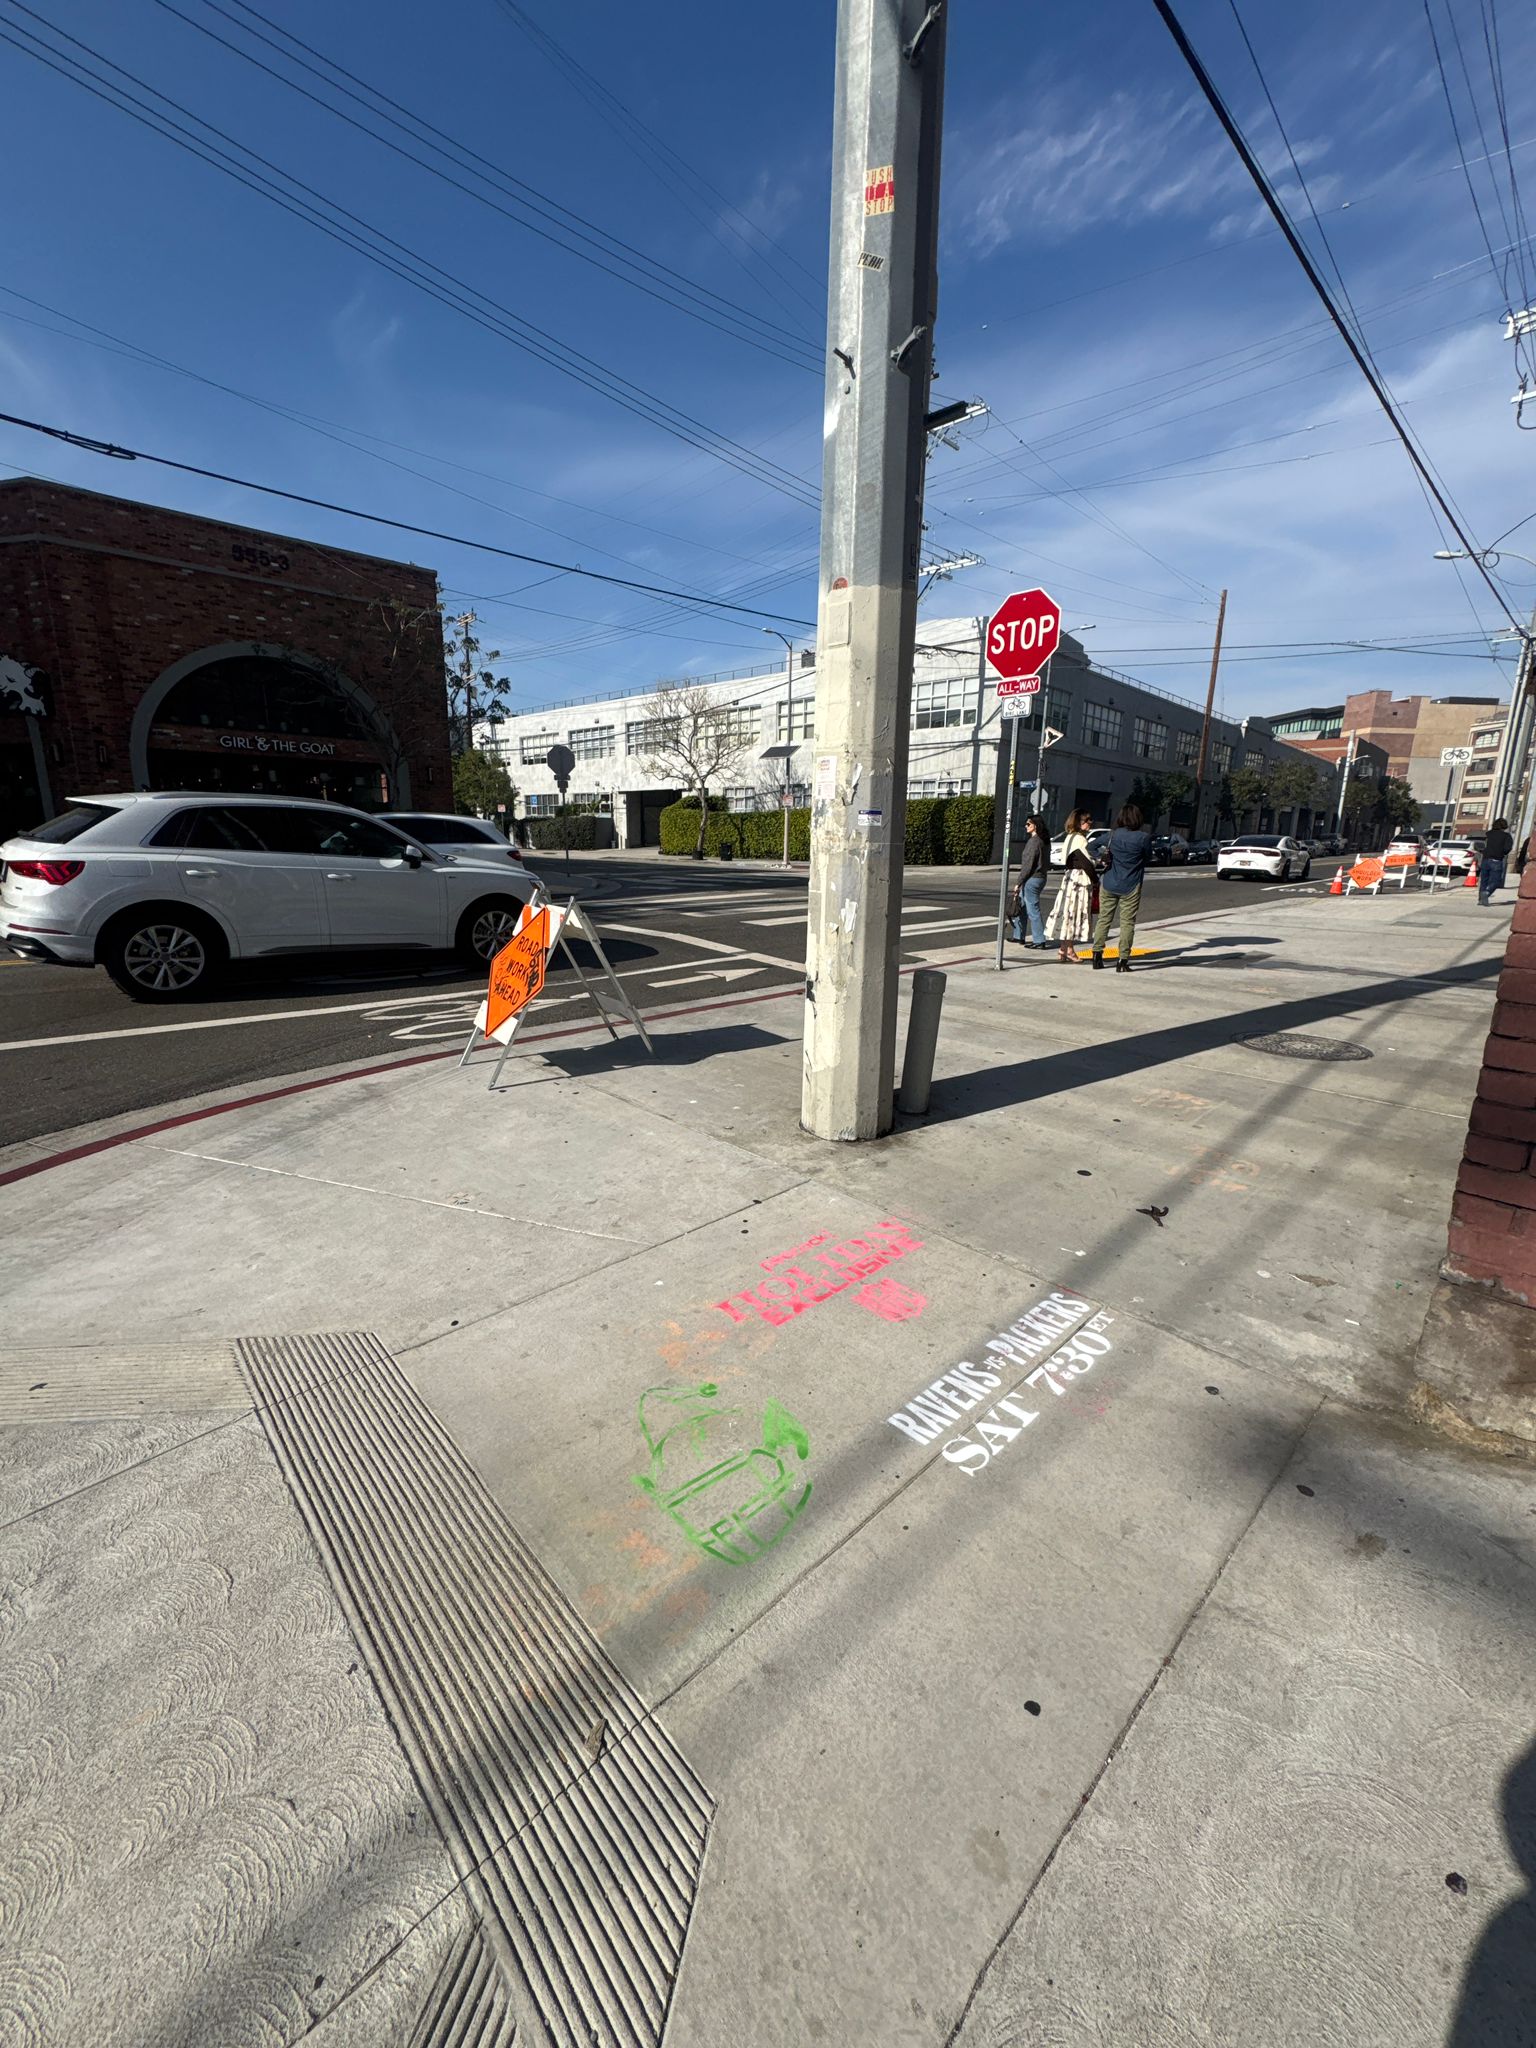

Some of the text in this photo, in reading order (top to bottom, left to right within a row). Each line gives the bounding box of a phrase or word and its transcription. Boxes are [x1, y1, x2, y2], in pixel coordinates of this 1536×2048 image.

[865, 196, 893, 215] STOP
[991, 614, 1055, 654] STOP
[998, 679, 1039, 695] ALL-WAY
[220, 735, 336, 755] GIRL & THE GOAT
[516, 936, 540, 957] ROAD
[506, 959, 529, 983] WORK
[494, 982, 521, 1006] AHEAD
[714, 1216, 912, 1323] HOLIDAY
[760, 1237, 925, 1327] EXCLUSIVE
[887, 1361, 1002, 1446] RAVENS
[986, 1292, 1091, 1366] PACKERS
[941, 1310, 1115, 1477] SAT 7:30 ET
